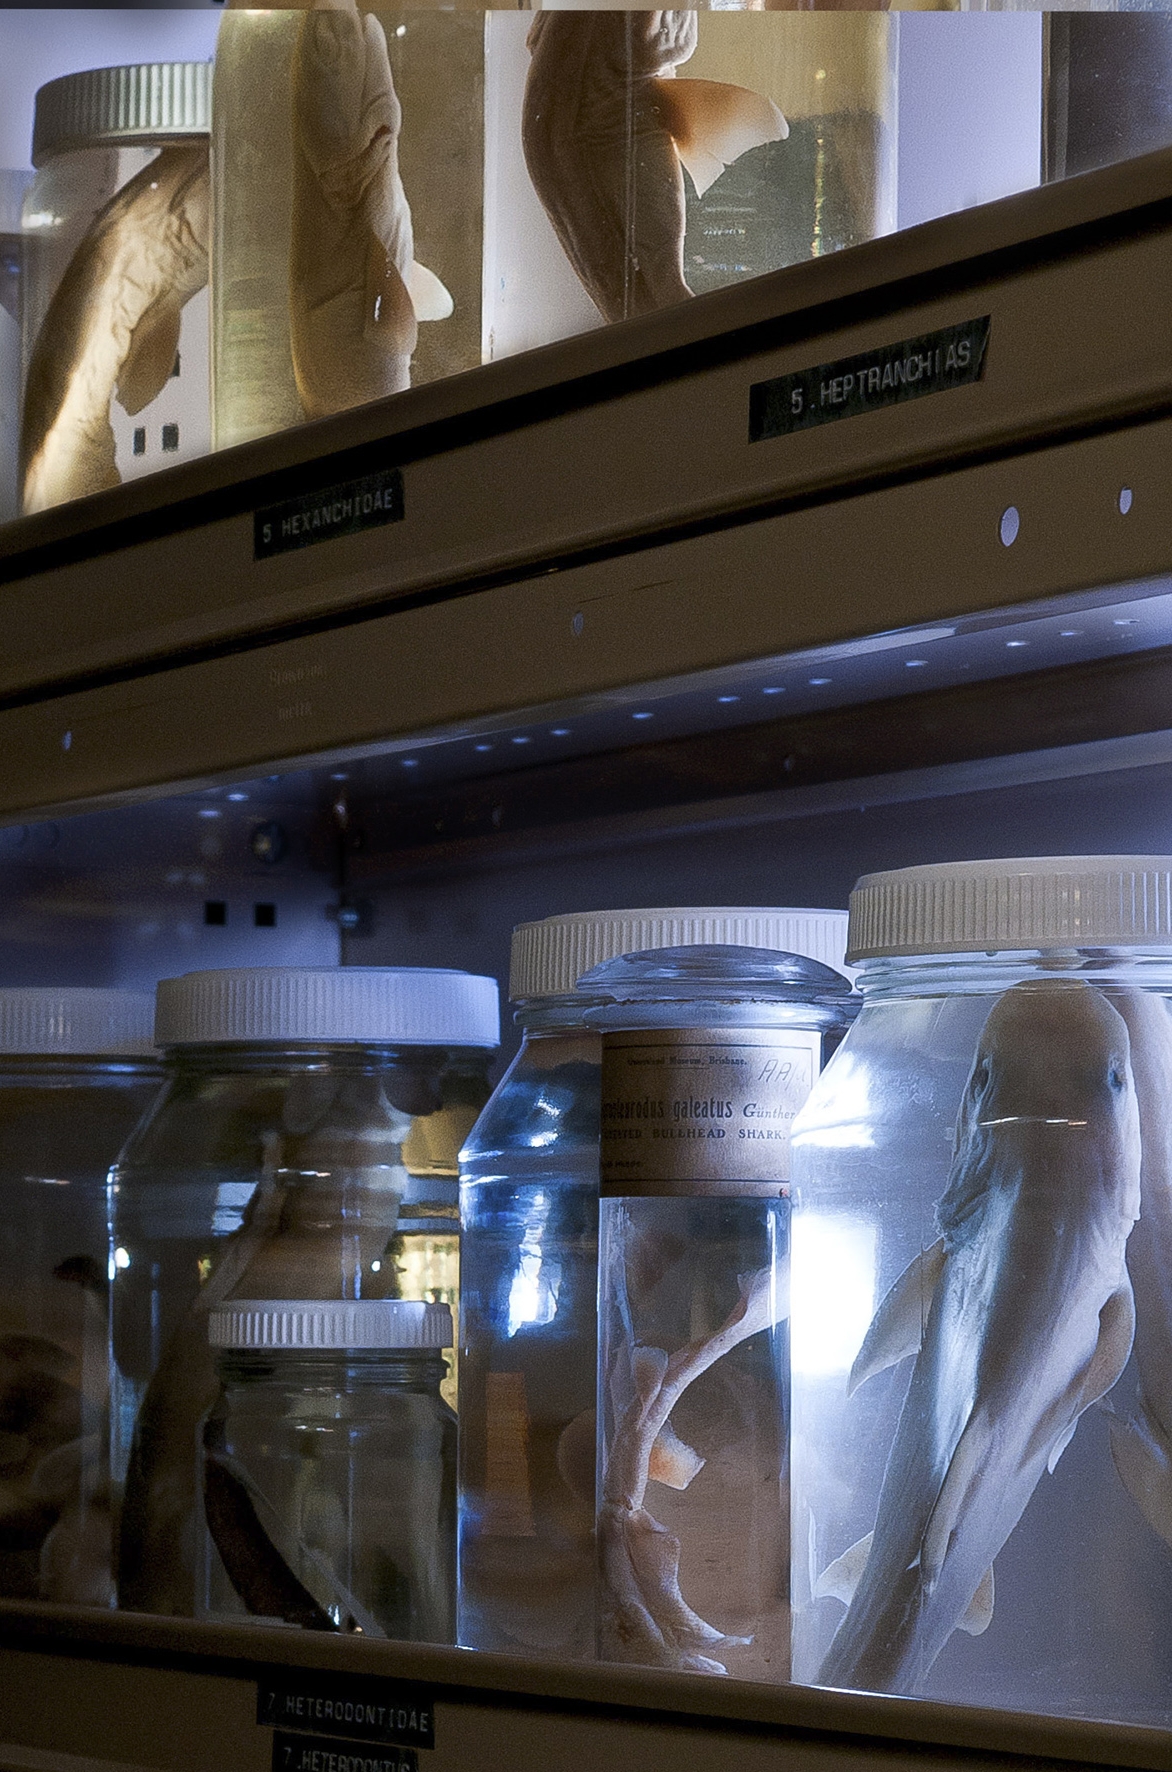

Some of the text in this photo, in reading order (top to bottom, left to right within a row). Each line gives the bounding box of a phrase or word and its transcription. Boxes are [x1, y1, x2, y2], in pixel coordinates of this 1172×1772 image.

[281, 488, 394, 537] HEXANCHIDAE
[673, 1095, 733, 1122] galeatus
[743, 1103, 796, 1120] Günther
[652, 1128, 726, 1140] BULLHEAD
[738, 1128, 786, 1140] SHARK.
[285, 1694, 429, 1733] HETERODONTIDAE
